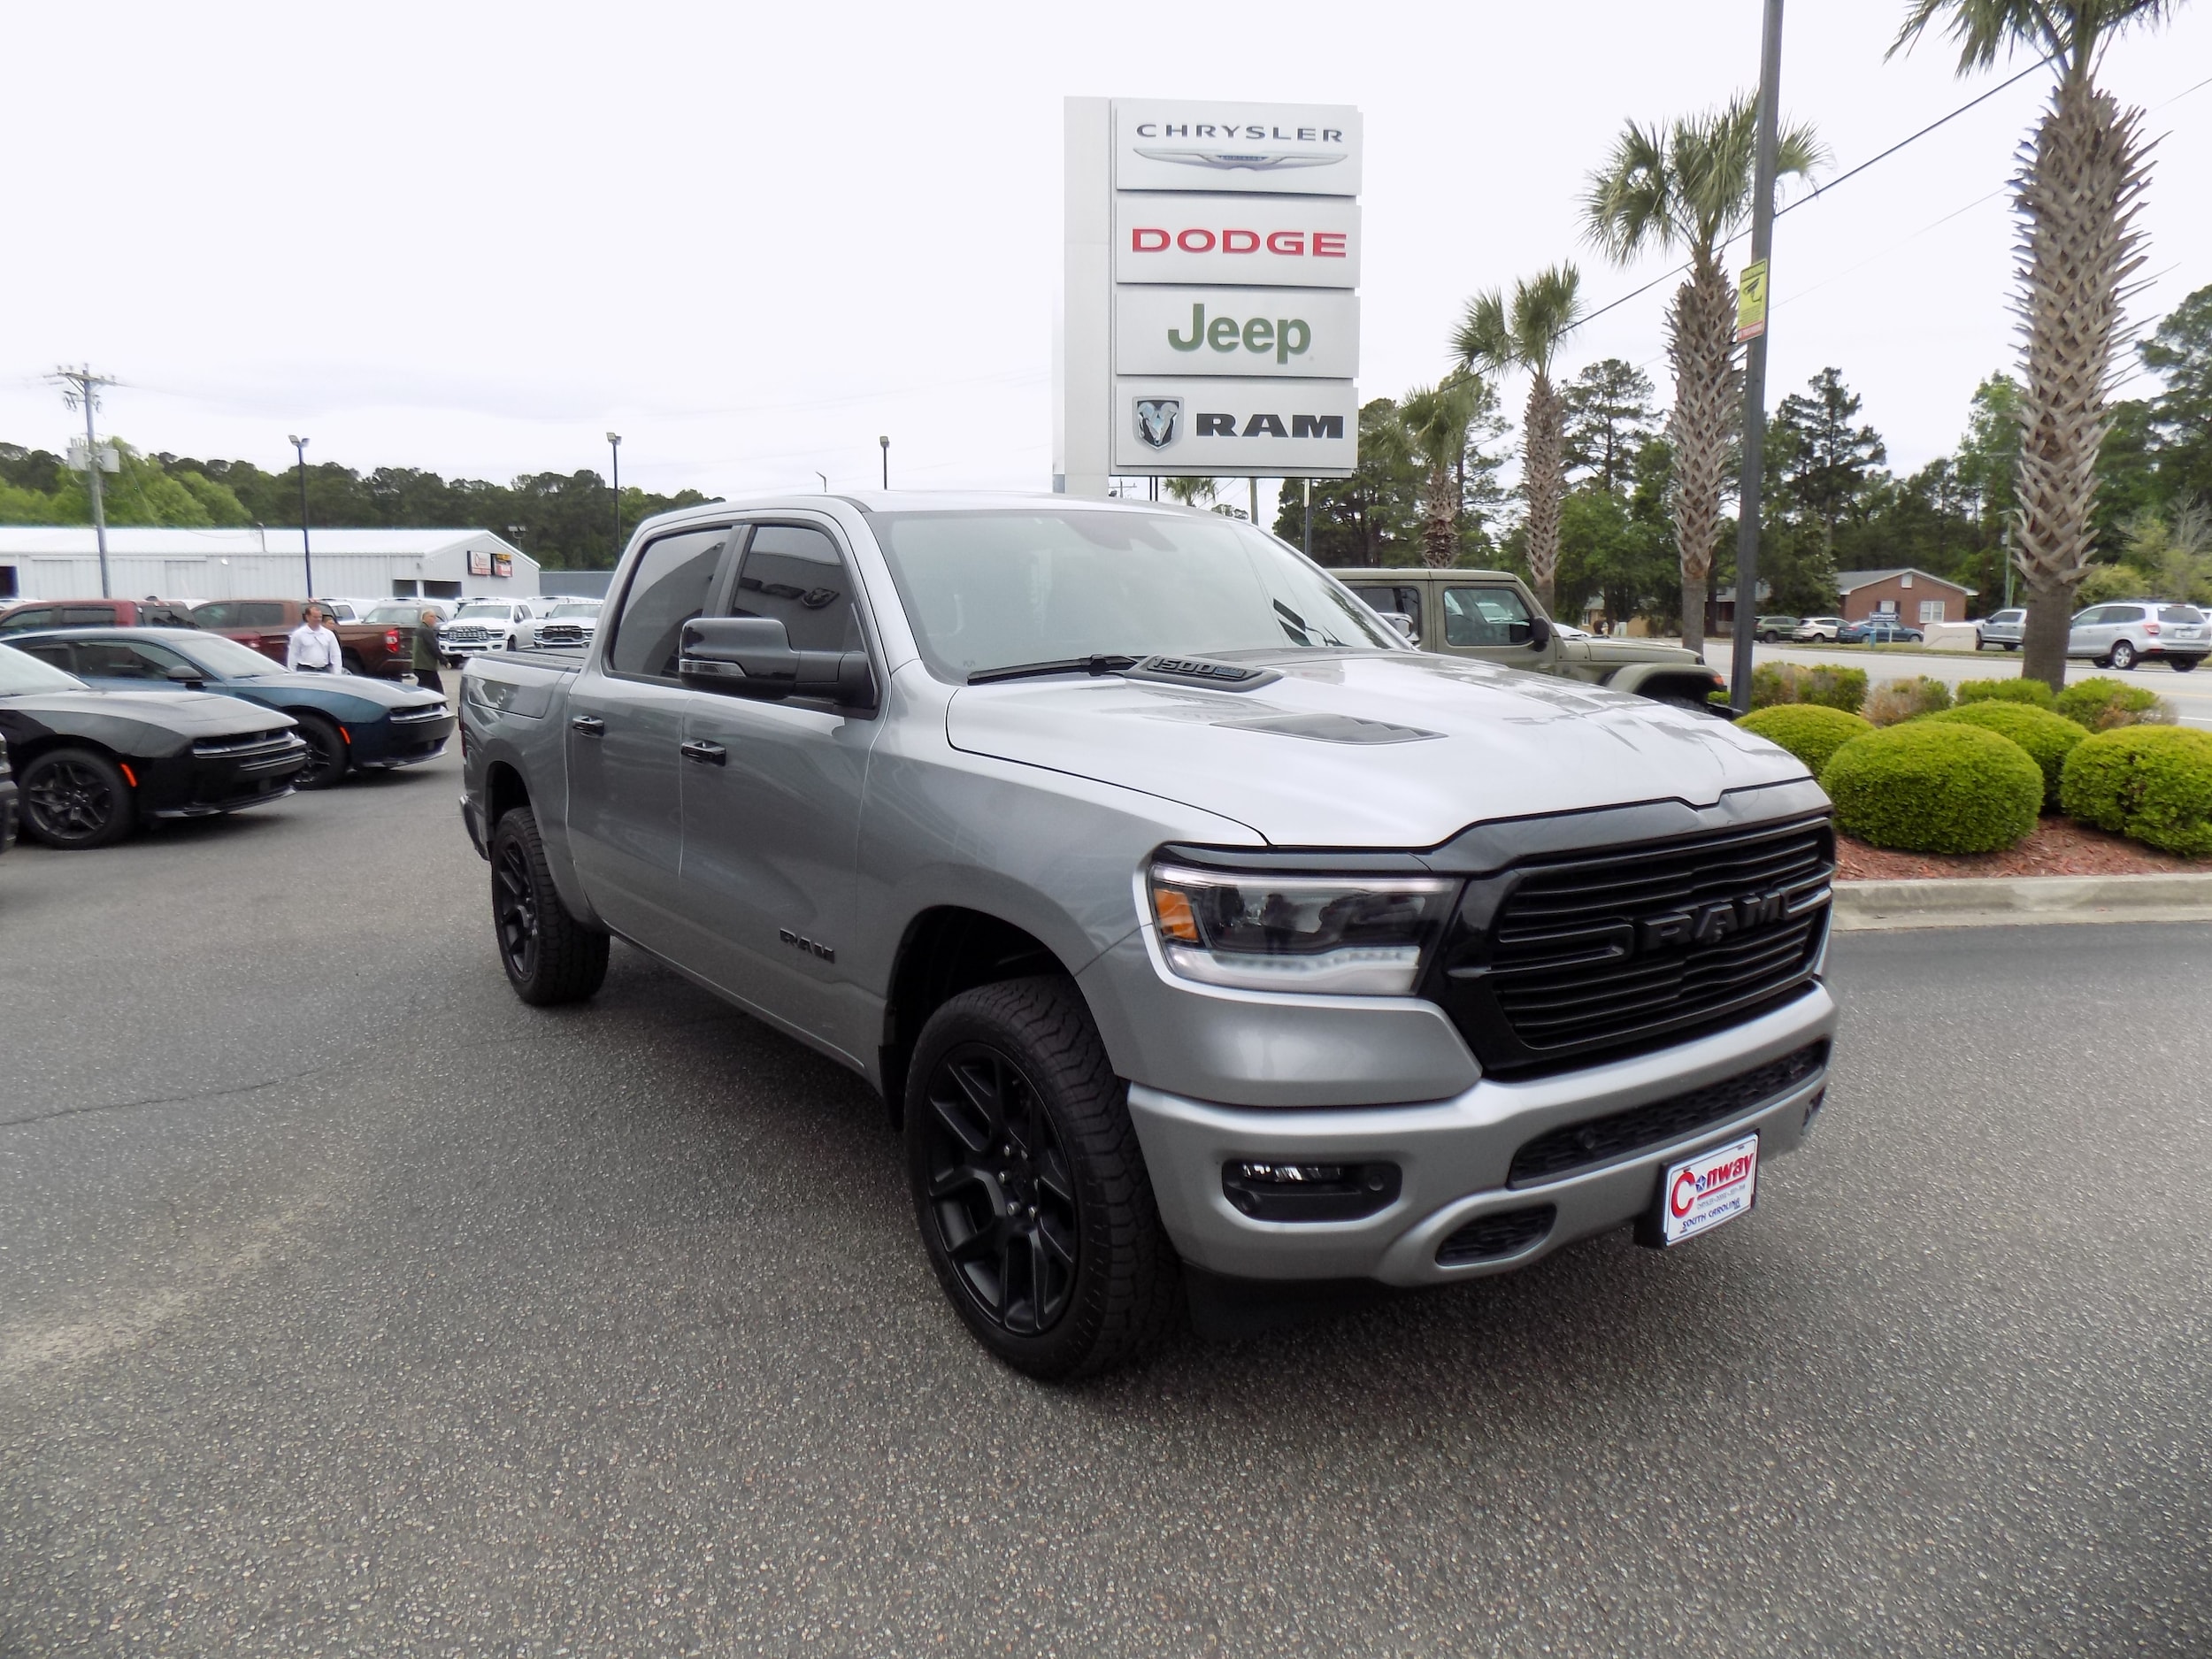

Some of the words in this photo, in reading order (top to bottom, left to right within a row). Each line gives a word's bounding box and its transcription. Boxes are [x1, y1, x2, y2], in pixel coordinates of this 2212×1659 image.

[1136, 124, 1343, 142] CHRYSLER
[1132, 228, 1347, 257] DODGE
[1167, 303, 1311, 365] Jeep
[1196, 413, 1344, 439] RAM
[1152, 657, 1217, 674] 1500
[1640, 891, 1781, 953] RAM
[780, 928, 835, 964] RAM
[1671, 1153, 1755, 1219] Conway
[1682, 1212, 1707, 1229] SOUTH
[1708, 1197, 1740, 1217] CAROLINA
